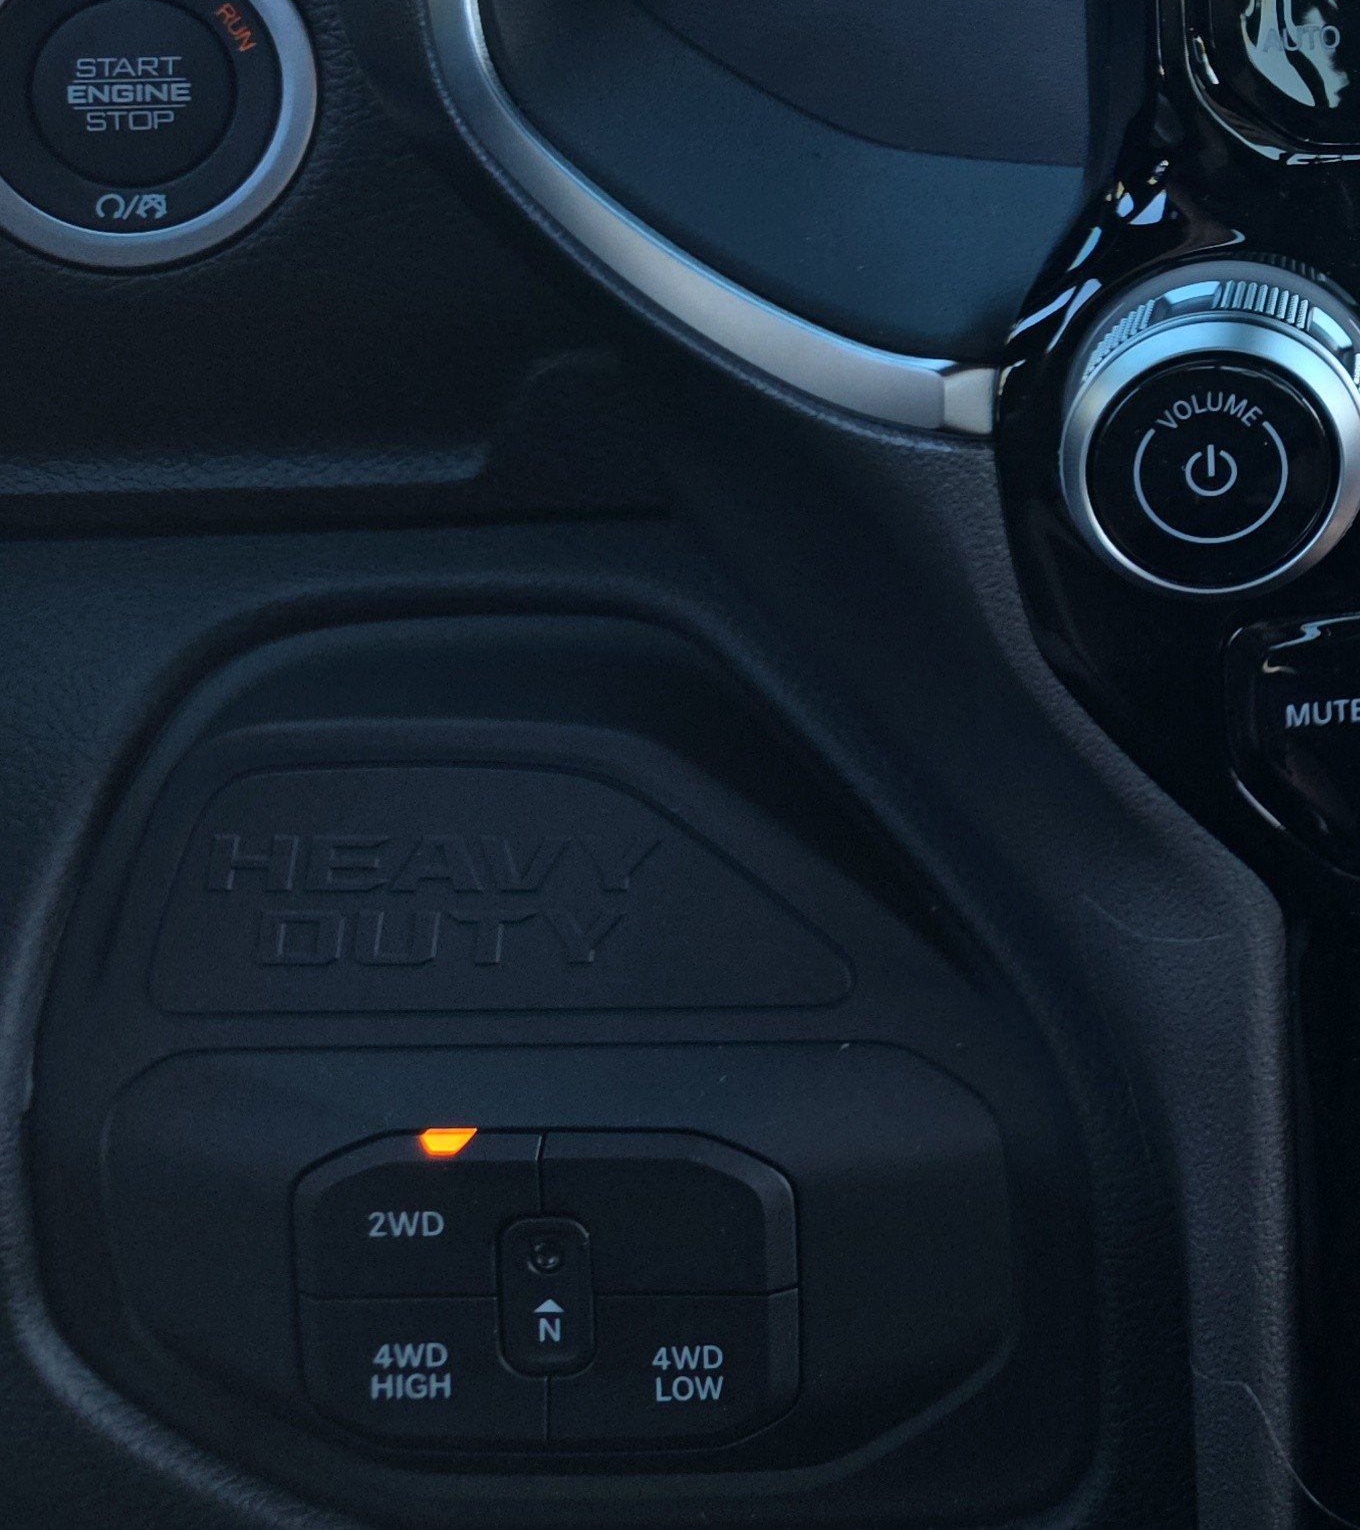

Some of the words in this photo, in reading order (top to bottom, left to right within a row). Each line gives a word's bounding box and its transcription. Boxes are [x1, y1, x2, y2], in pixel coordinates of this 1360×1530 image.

[214, 2, 257, 53] RUN
[1263, 25, 1341, 52] AUTO
[76, 56, 183, 79] START
[67, 82, 192, 105] ENGINE
[86, 110, 175, 132] STOP
[1155, 390, 1264, 432] VOLUME
[208, 833, 662, 893] HEAVY
[258, 909, 629, 967] DUTY
[368, 1211, 445, 1238] 2WD
[538, 1318, 561, 1343] N
[373, 1342, 449, 1368] 4WD
[652, 1345, 724, 1371] 4WD
[371, 1373, 452, 1400] HIGH
[655, 1376, 725, 1402] LOW
